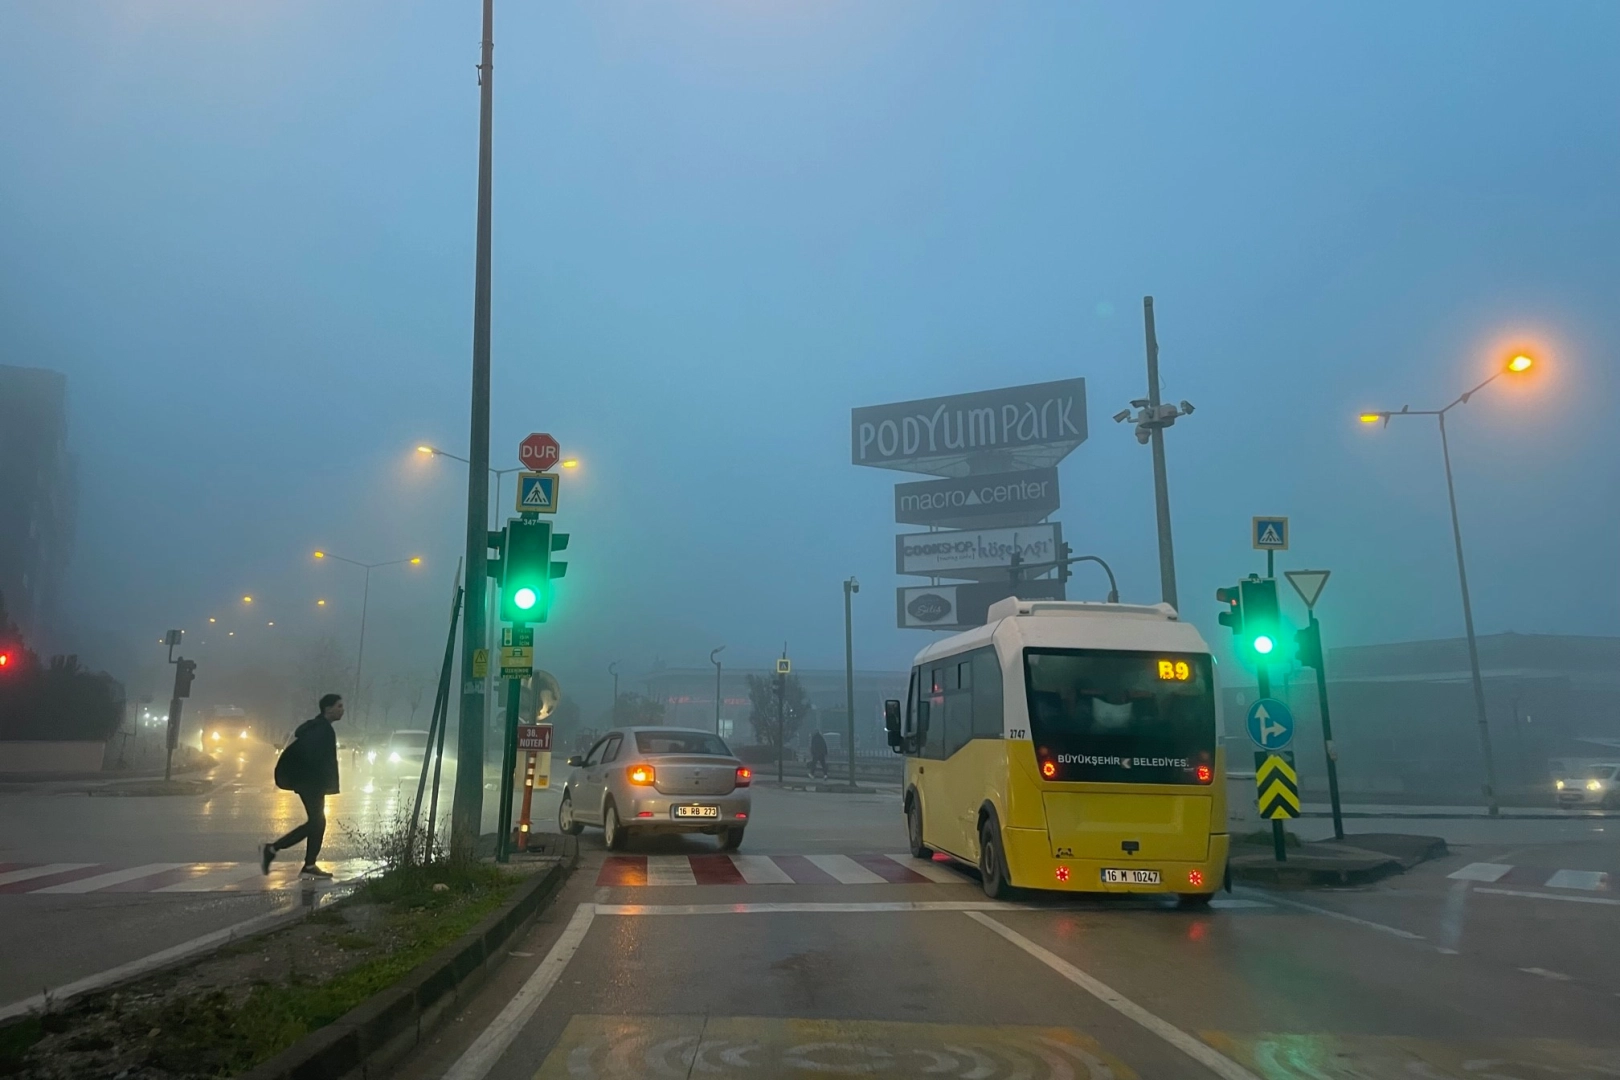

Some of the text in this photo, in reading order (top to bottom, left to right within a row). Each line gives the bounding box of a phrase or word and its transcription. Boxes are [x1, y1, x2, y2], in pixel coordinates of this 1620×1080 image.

[522, 445, 556, 459] DUR
[901, 479, 1049, 511] macro center
[1158, 661, 1189, 680] B9
[1009, 728, 1026, 740] 2747
[519, 738, 544, 748] NOTER
[1057, 754, 1120, 767] BÜYÜKŞEHİR
[679, 807, 687, 815] 16
[690, 807, 701, 815] RB
[1107, 870, 1158, 883] 16 M 10247
